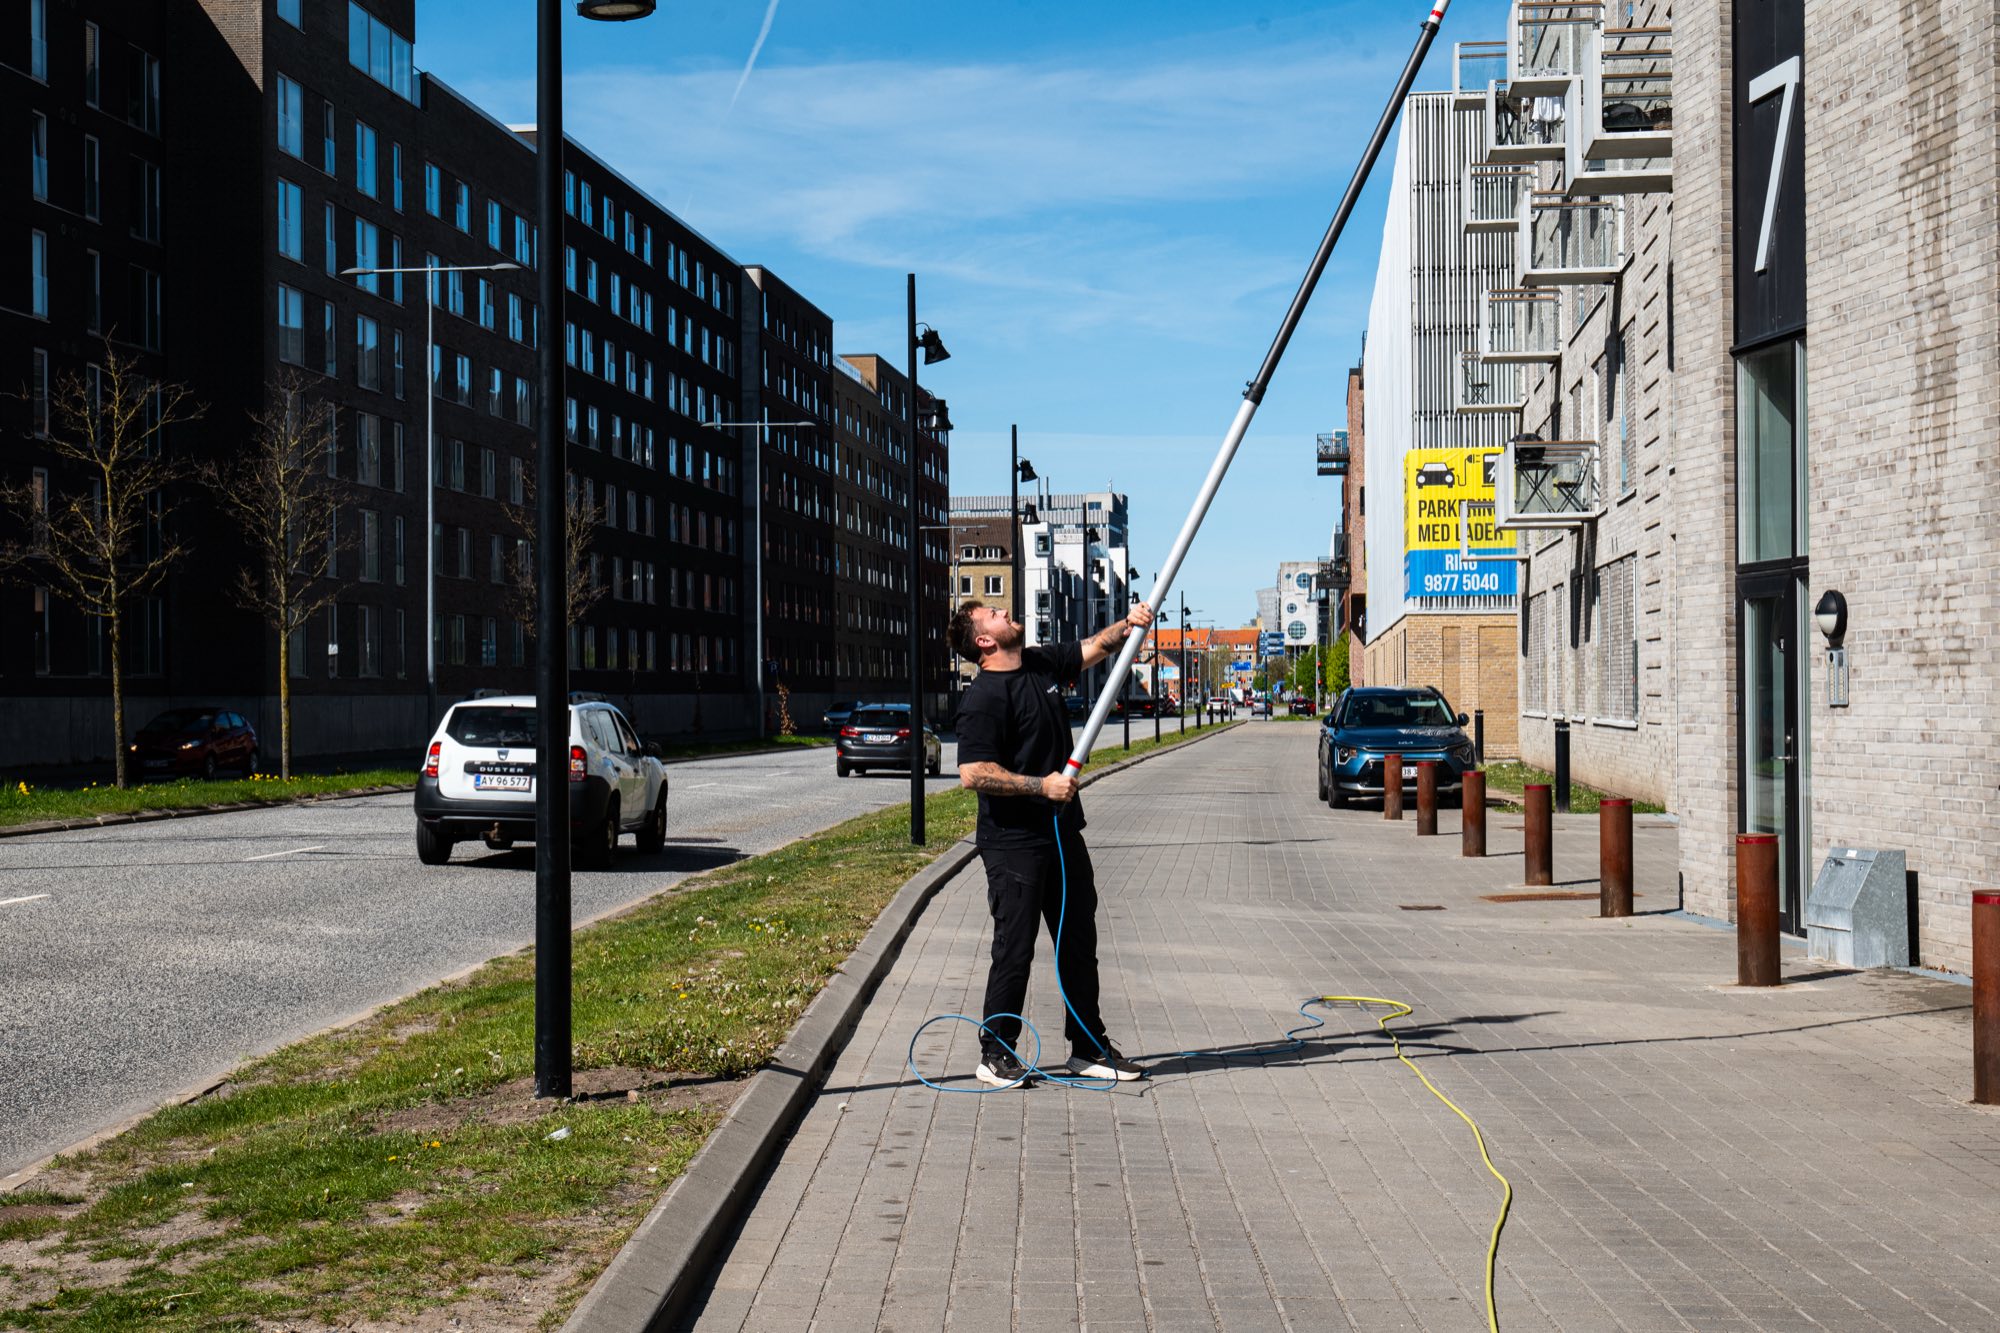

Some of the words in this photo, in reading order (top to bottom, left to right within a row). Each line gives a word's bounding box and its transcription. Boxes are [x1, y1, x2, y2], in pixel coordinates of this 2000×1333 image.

[1749, 56, 1799, 272] 7
[1418, 524, 1451, 542] MED
[1424, 574, 1459, 592] 9877
[1463, 573, 1499, 591] 5040
[481, 776, 494, 785] AY
[496, 776, 508, 786] 96
[510, 777, 527, 786] 577
